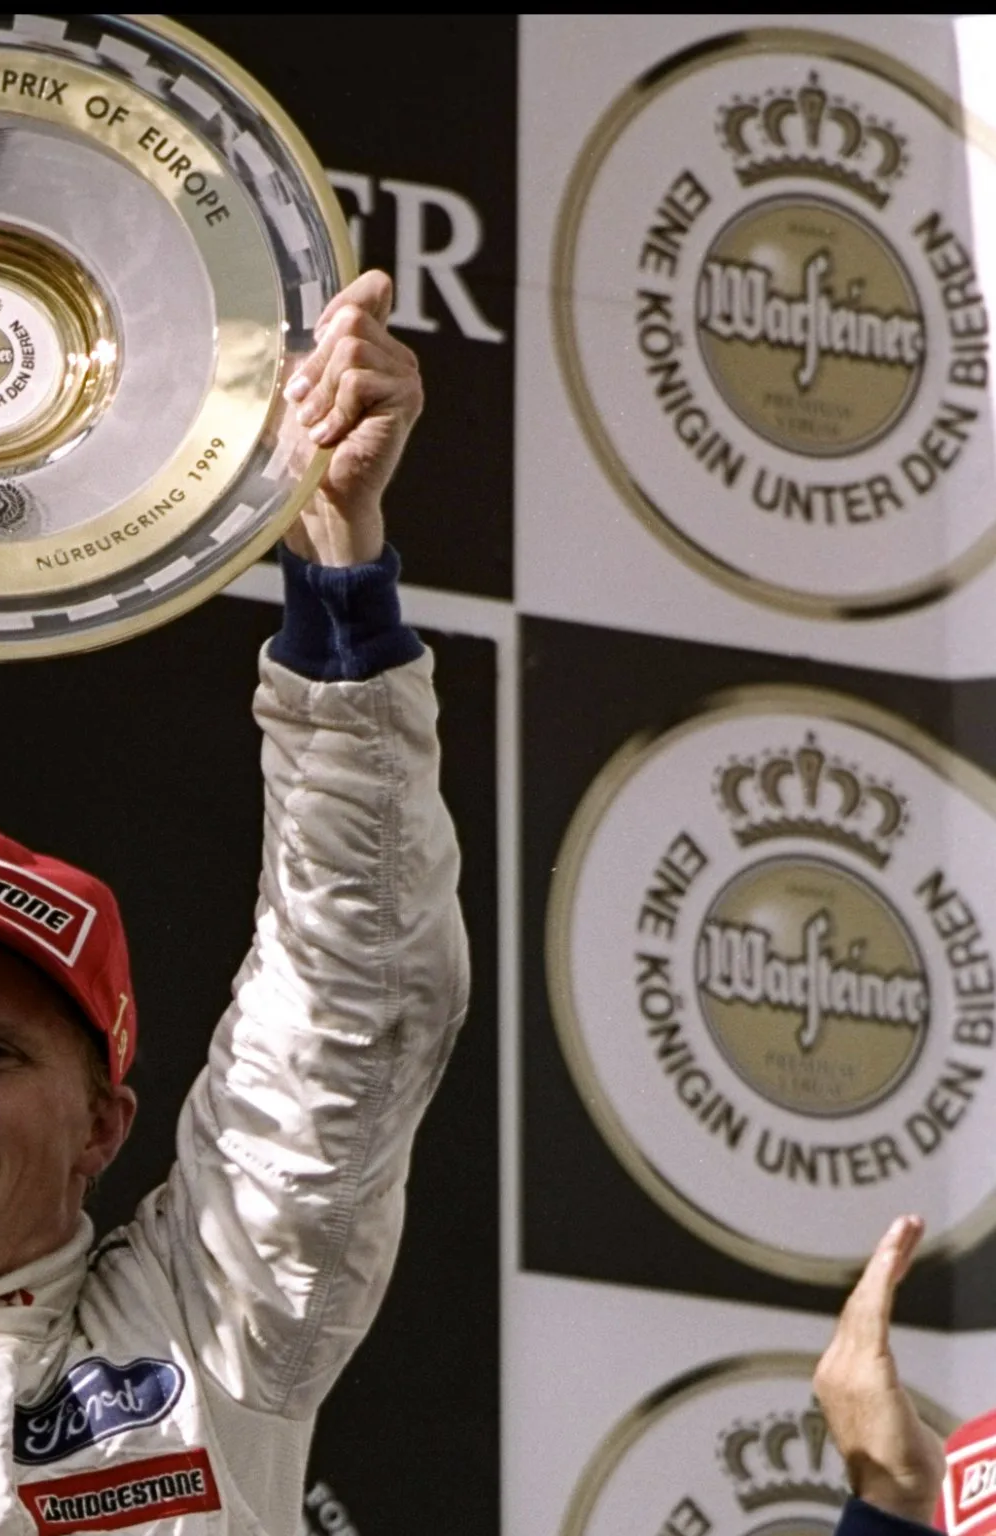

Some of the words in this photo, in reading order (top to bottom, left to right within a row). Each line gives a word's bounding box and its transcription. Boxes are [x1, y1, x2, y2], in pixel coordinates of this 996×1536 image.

[1, 69, 68, 105] PRIX
[85, 95, 130, 126] OF
[137, 127, 230, 227] EUROPE
[640, 168, 712, 278] EINE
[9, 319, 35, 371] BIEREN
[913, 211, 990, 388] BIEREN
[5, 372, 31, 400] DEN
[635, 289, 745, 488] KÖNIGIN
[753, 467, 903, 525] UNTER
[901, 401, 979, 494] DEN
[36, 487, 186, 571] NÜRBURGRING
[188, 437, 226, 482] 1999
[637, 830, 708, 942] EINE
[915, 869, 995, 1047] BIEREN
[635, 952, 749, 1150] KÖNIGIN
[755, 1129, 909, 1187] UNTER
[905, 1058, 985, 1156] DEN
[24, 1378, 144, 1455] Ford
[35, 1469, 204, 1522] BRIDGESTONE
